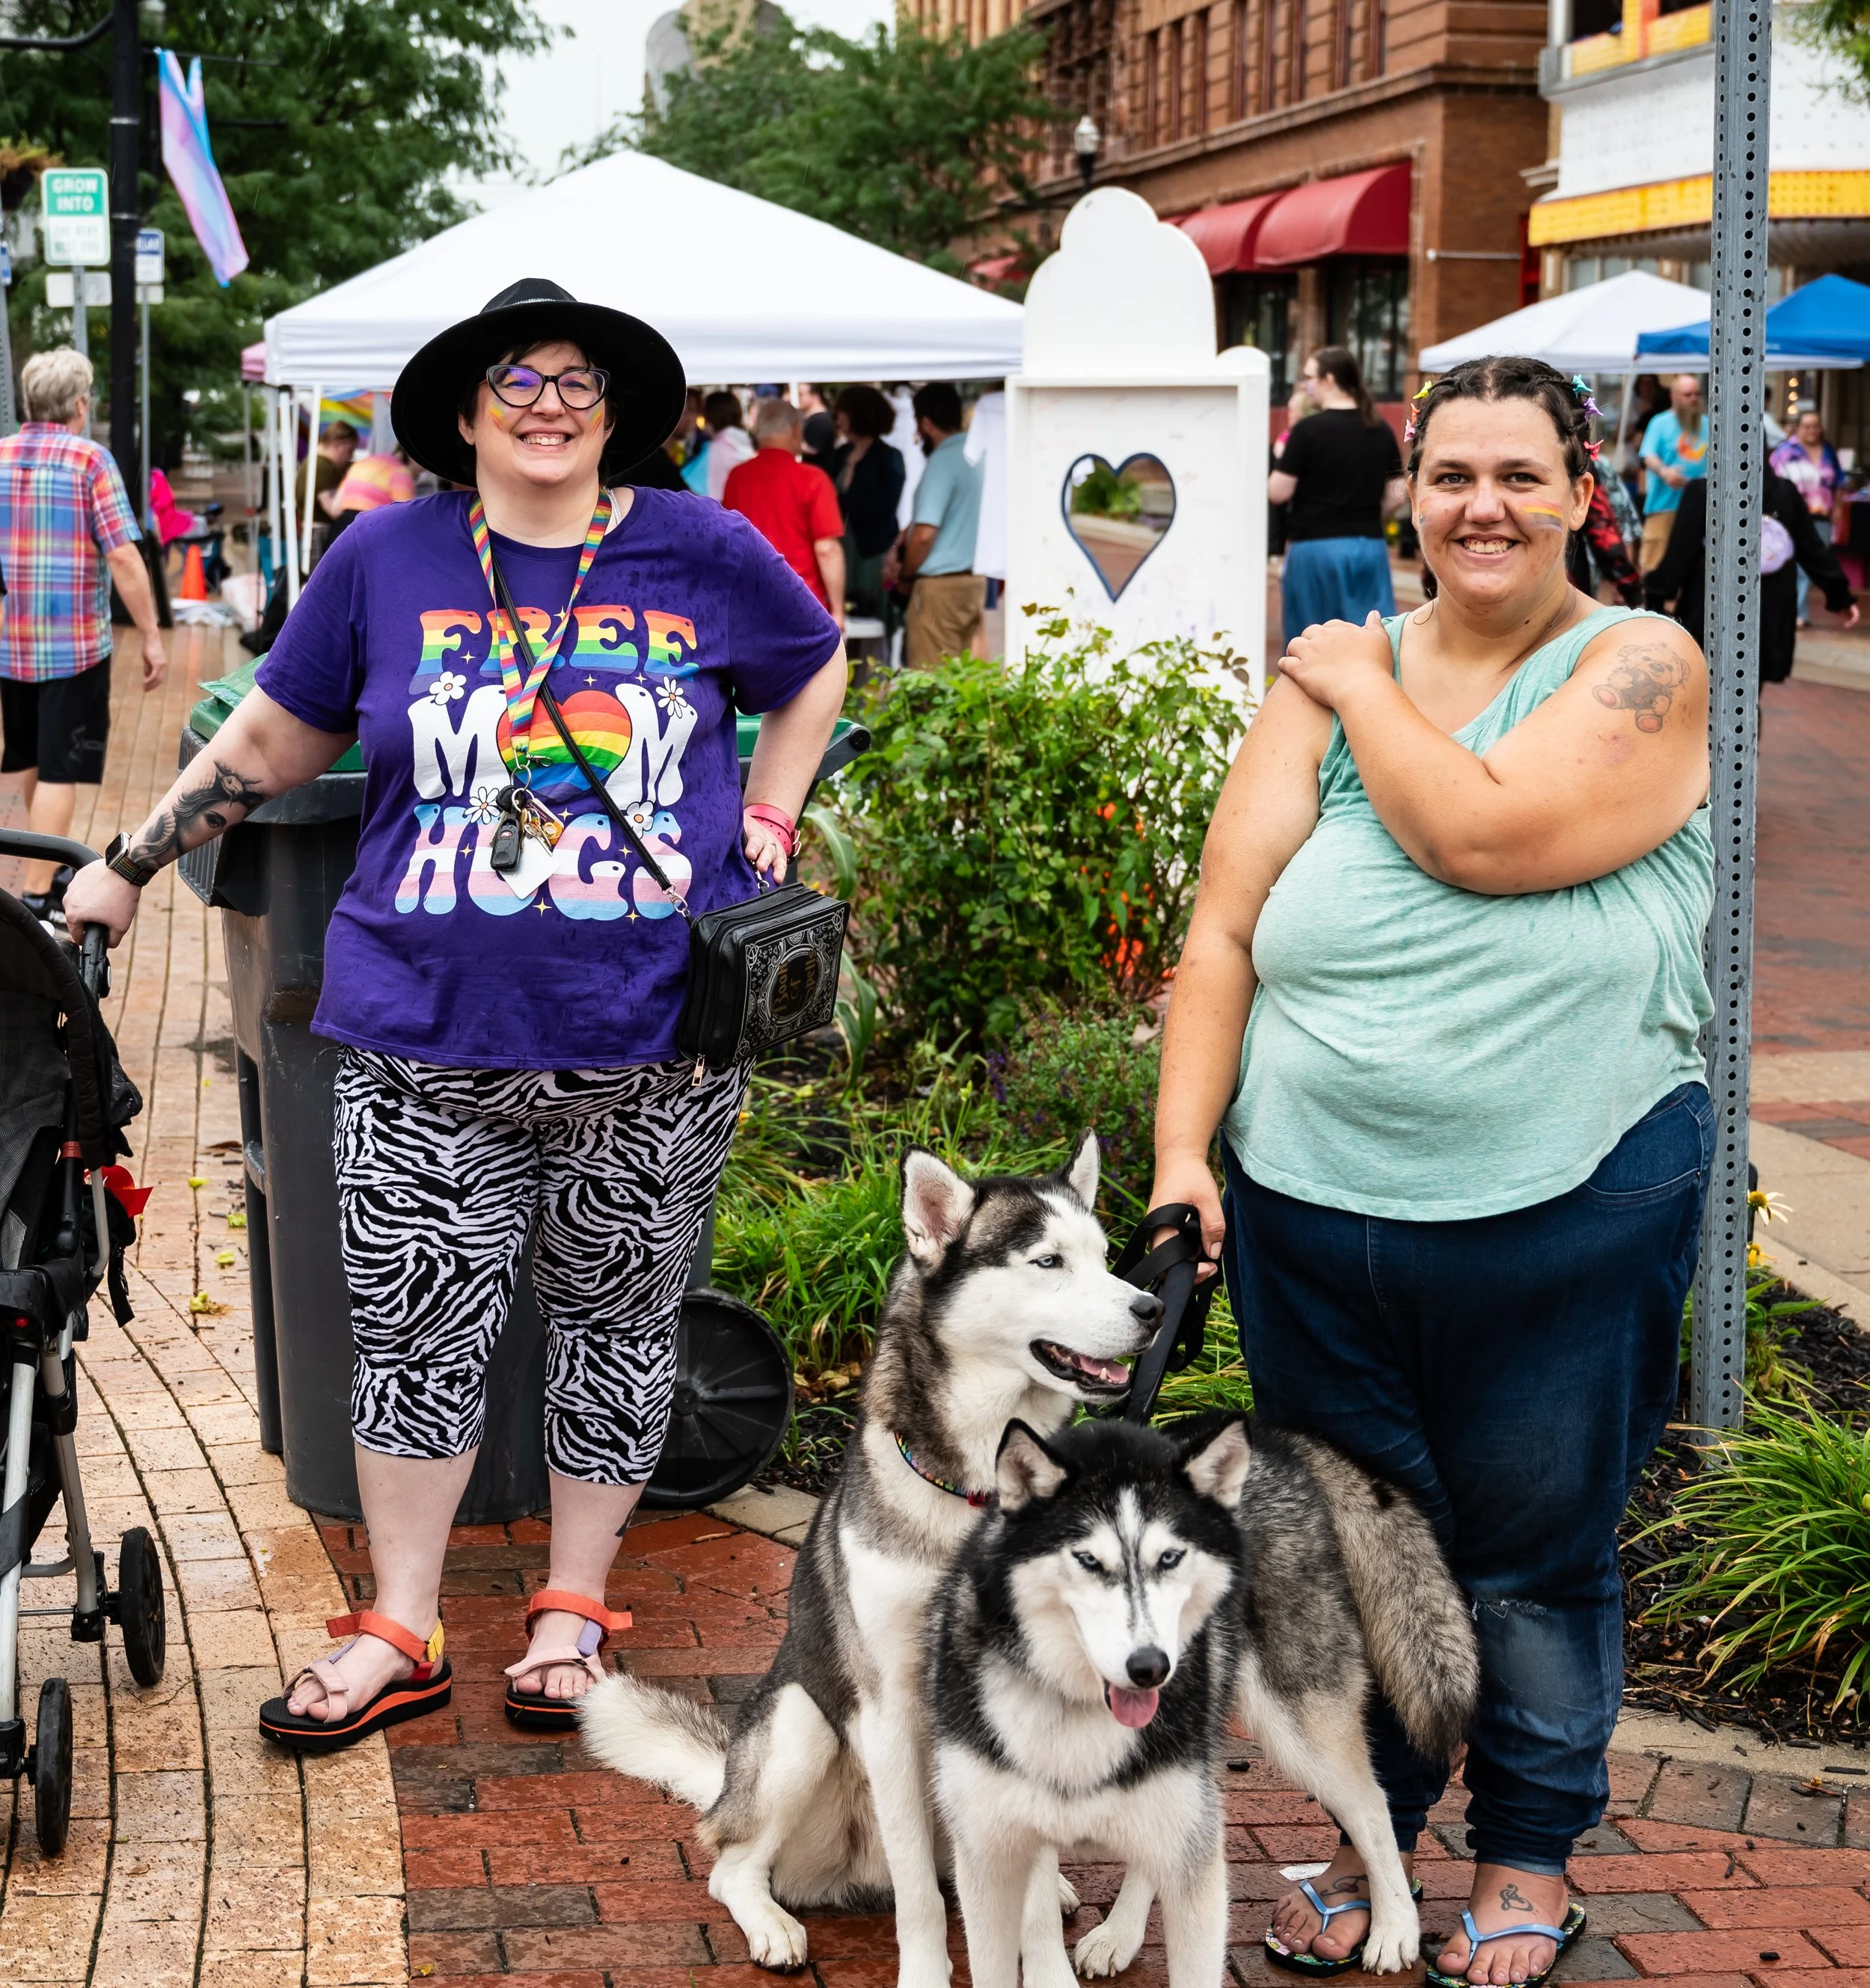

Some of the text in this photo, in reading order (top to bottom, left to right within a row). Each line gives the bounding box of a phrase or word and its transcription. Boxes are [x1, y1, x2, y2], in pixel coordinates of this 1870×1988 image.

[52, 177, 98, 194] GROW
[57, 196, 94, 212] INTO
[408, 605, 700, 694] FREE
[395, 803, 693, 921] HUGS
[771, 960, 788, 1013] Book
